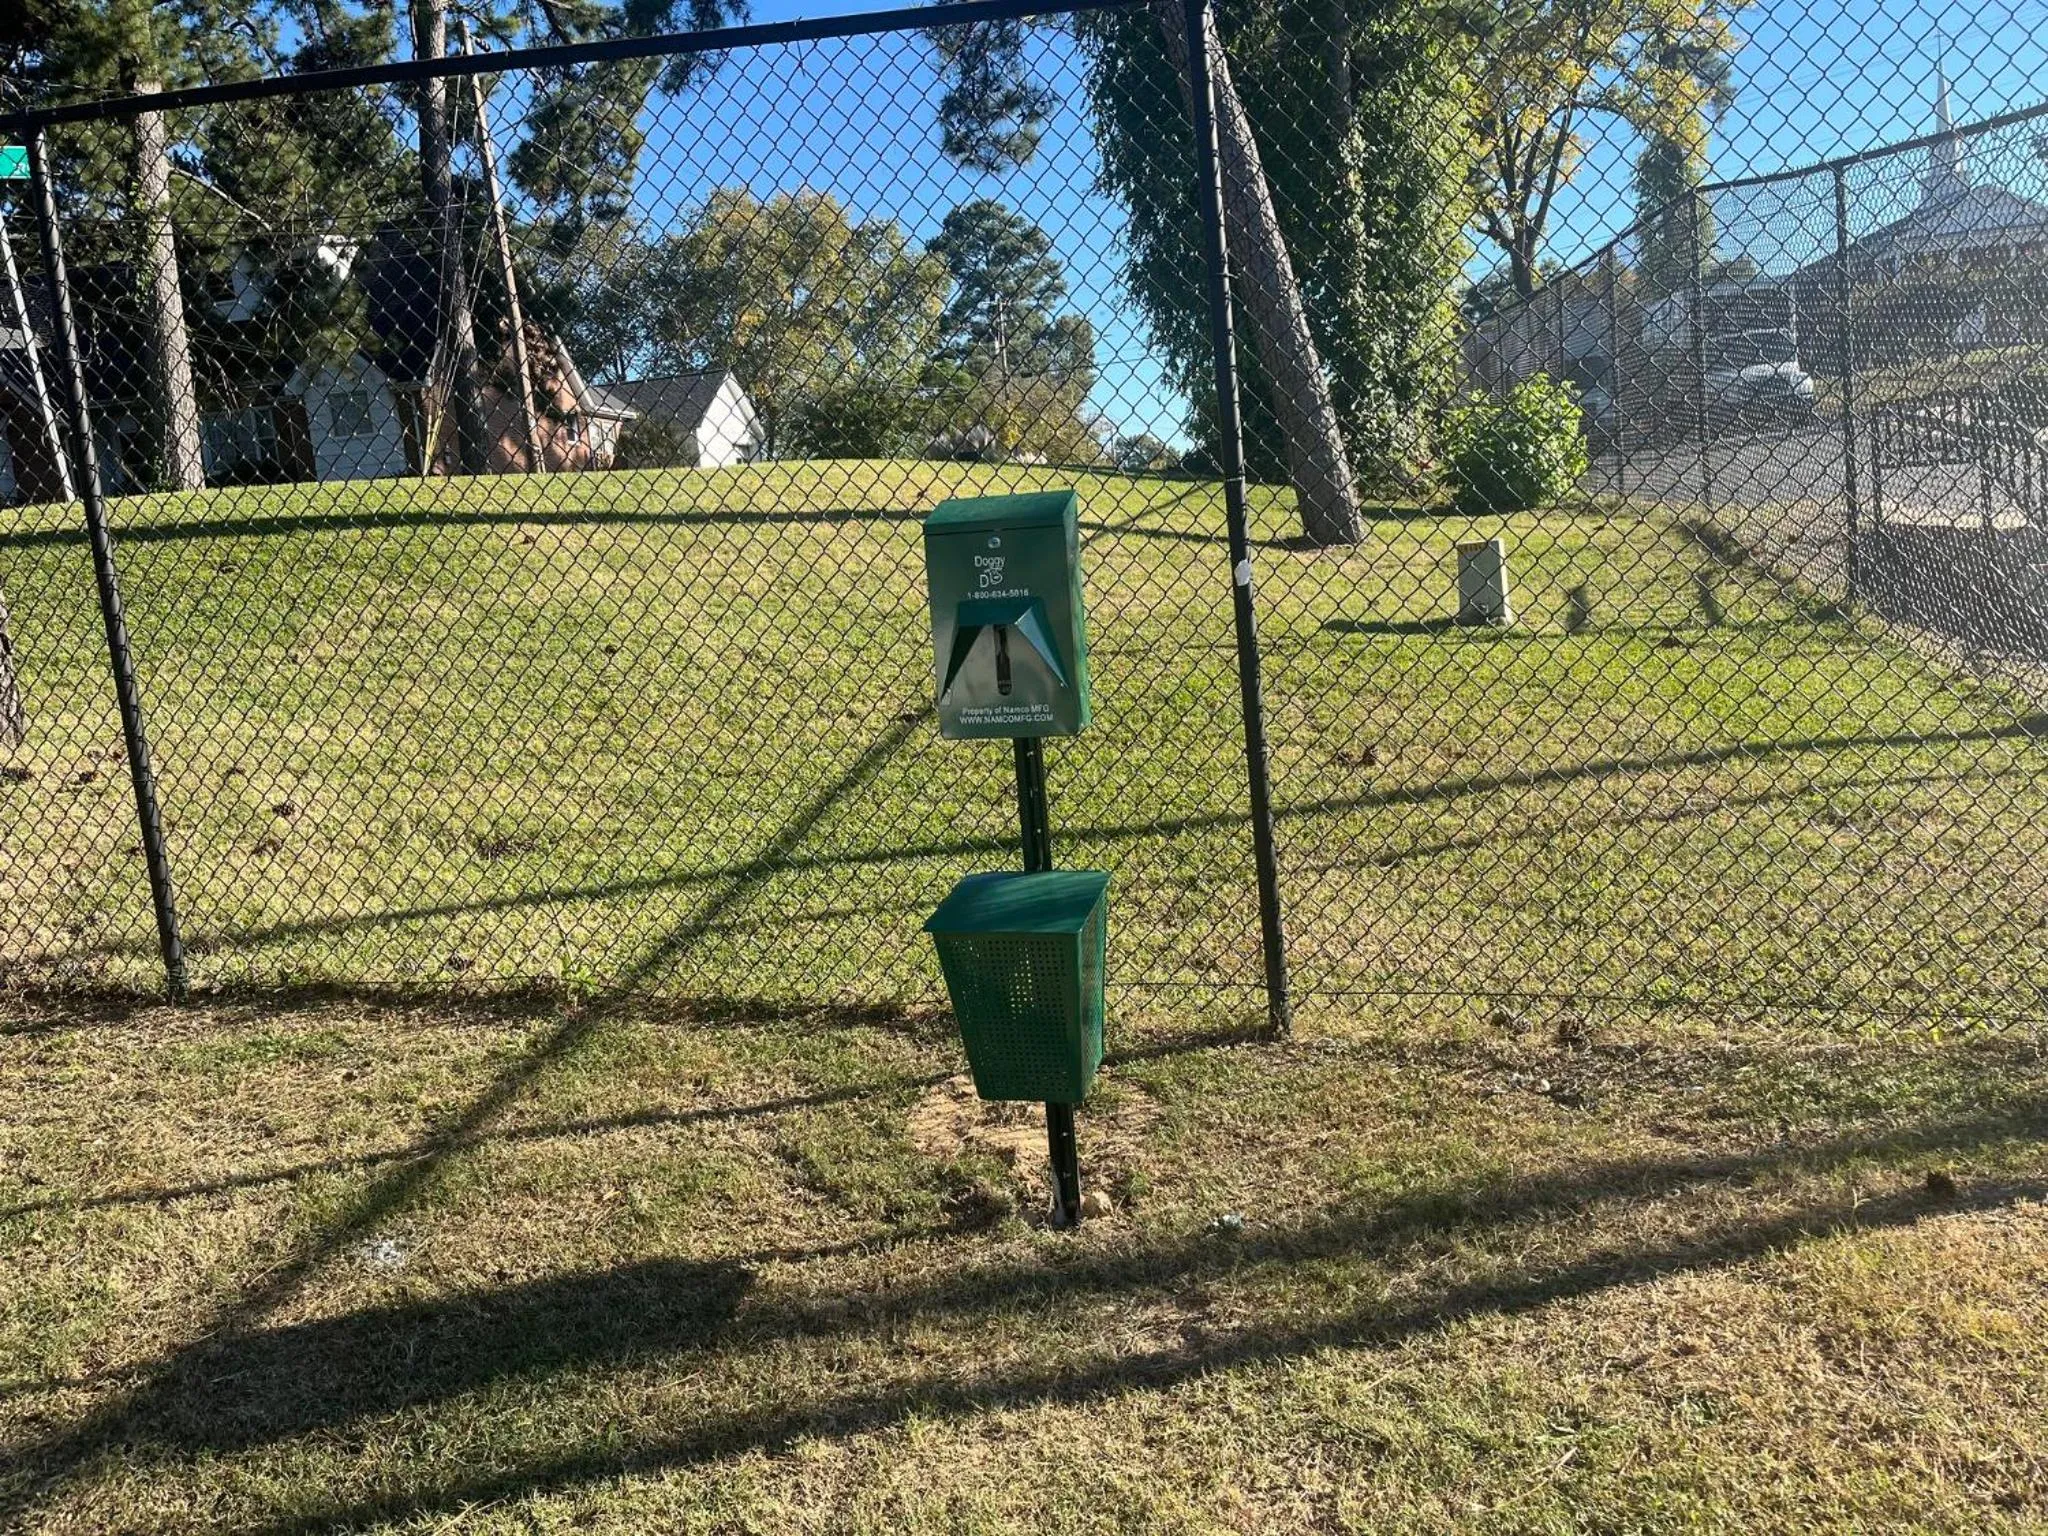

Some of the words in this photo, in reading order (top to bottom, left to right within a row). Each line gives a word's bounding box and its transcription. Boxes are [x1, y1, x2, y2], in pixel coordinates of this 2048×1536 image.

[974, 555, 1005, 570] Doggy
[962, 707, 992, 717] Property
[993, 705, 1001, 714] of
[1003, 706, 1030, 714] Namco
[1031, 703, 1050, 713] MFG
